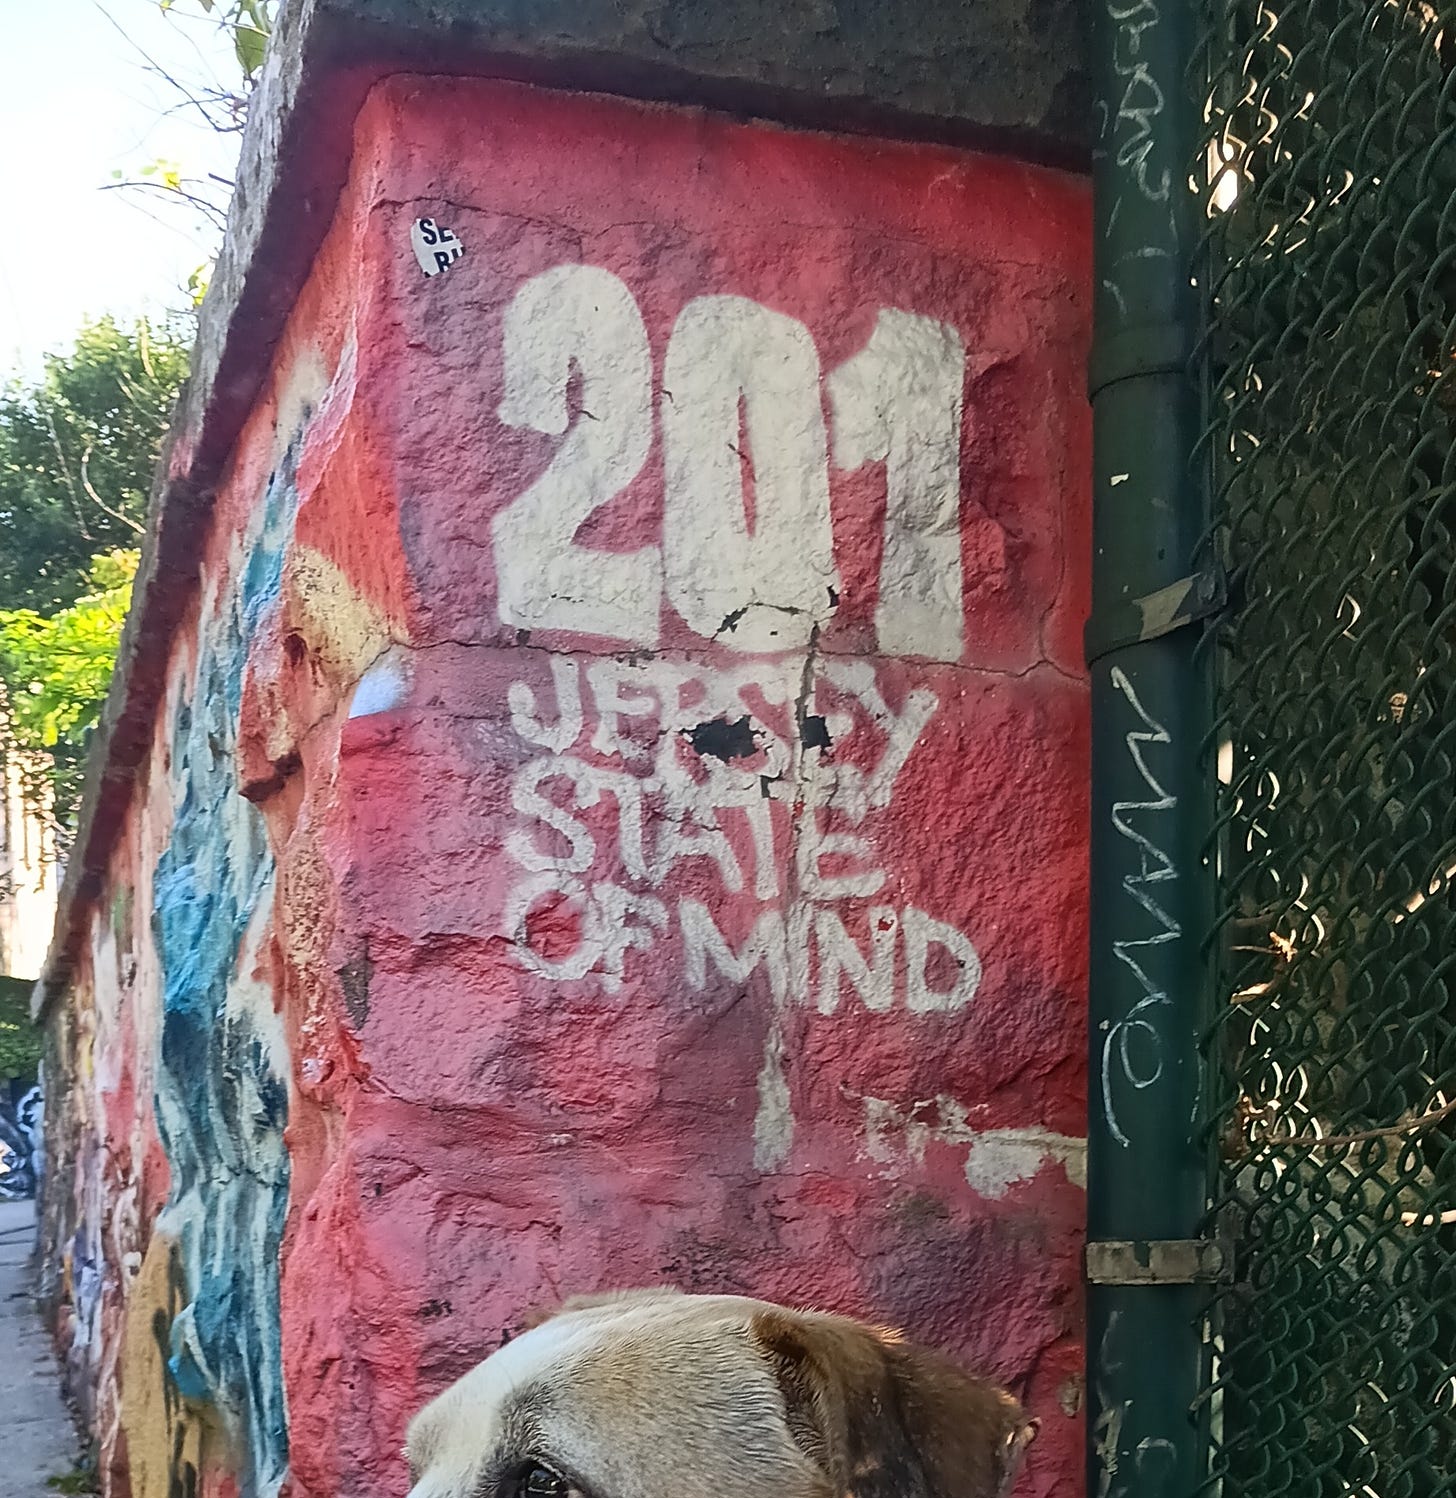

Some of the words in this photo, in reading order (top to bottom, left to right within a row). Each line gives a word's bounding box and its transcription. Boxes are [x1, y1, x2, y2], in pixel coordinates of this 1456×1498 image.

[491, 263, 965, 662] 201
[508, 656, 939, 816] JERSEY
[505, 754, 886, 899] STATE
[505, 871, 669, 994] OF
[679, 897, 984, 1016] MIND
